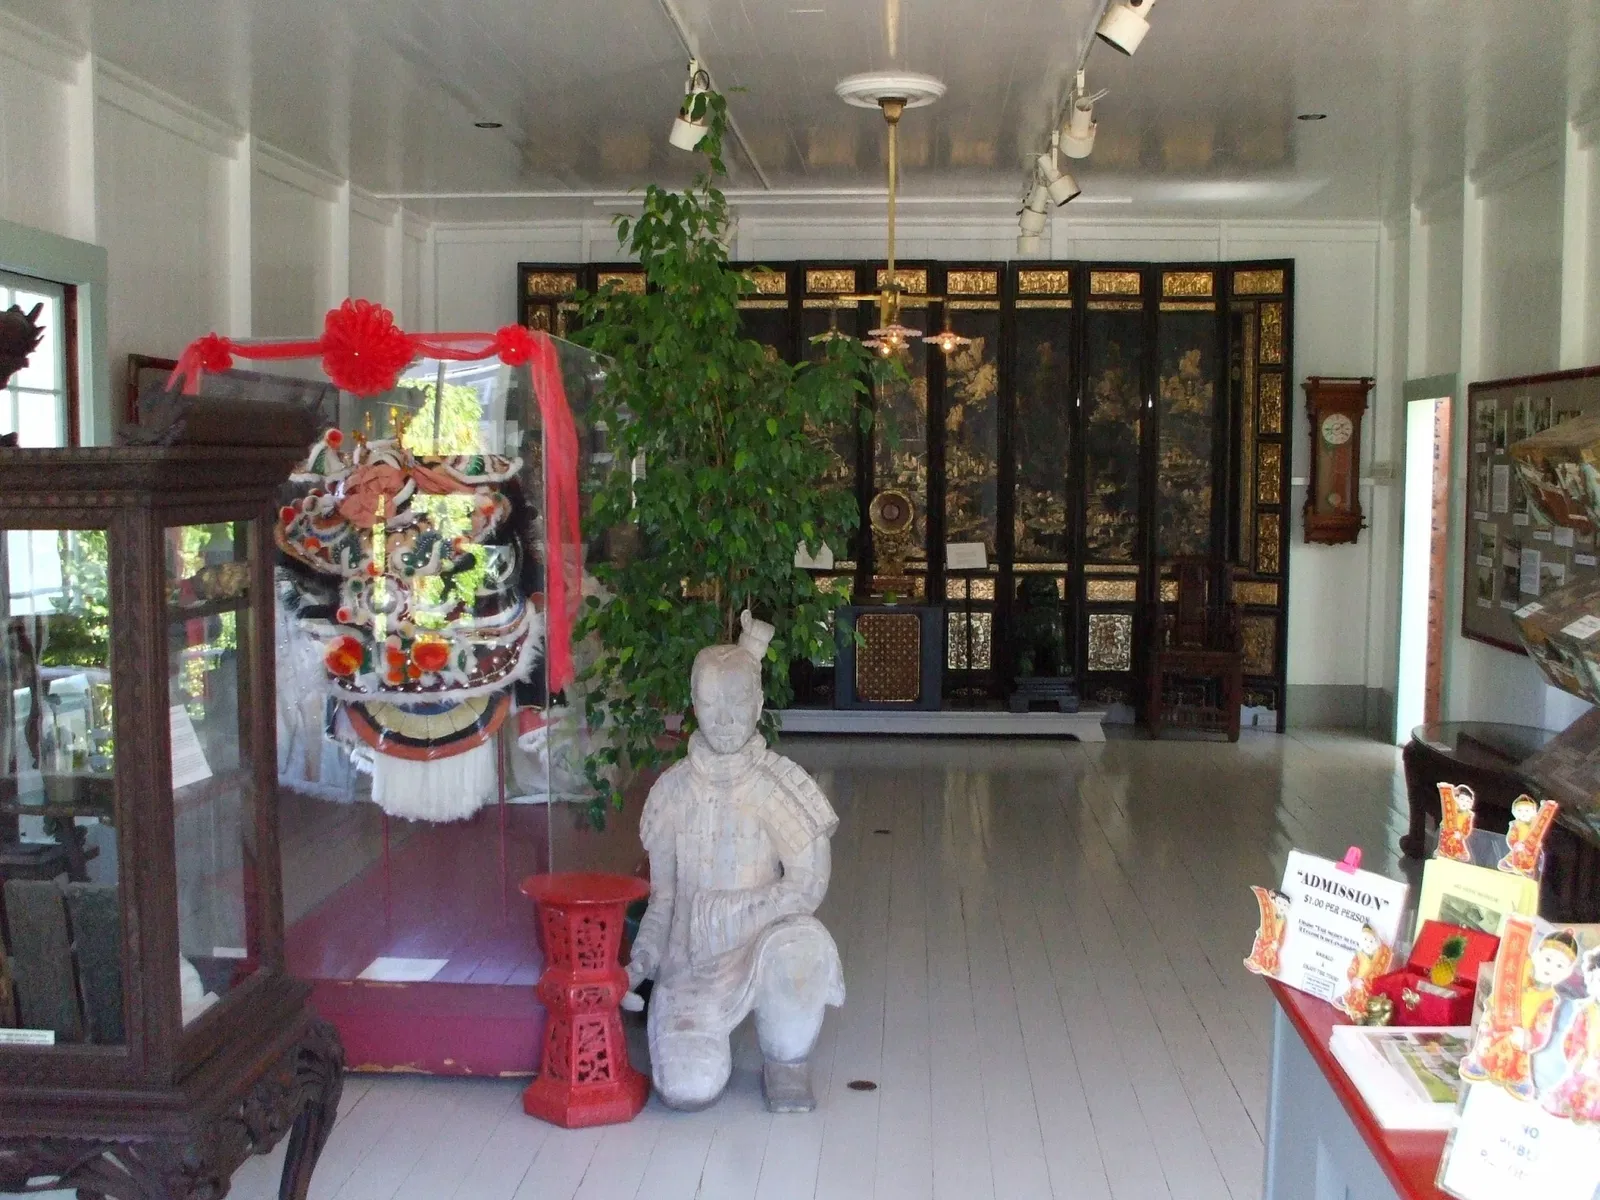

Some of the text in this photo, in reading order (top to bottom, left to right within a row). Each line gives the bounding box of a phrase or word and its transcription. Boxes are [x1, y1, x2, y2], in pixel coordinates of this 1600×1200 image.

[1304, 894, 1370, 924] $1.00 PER PERSON
